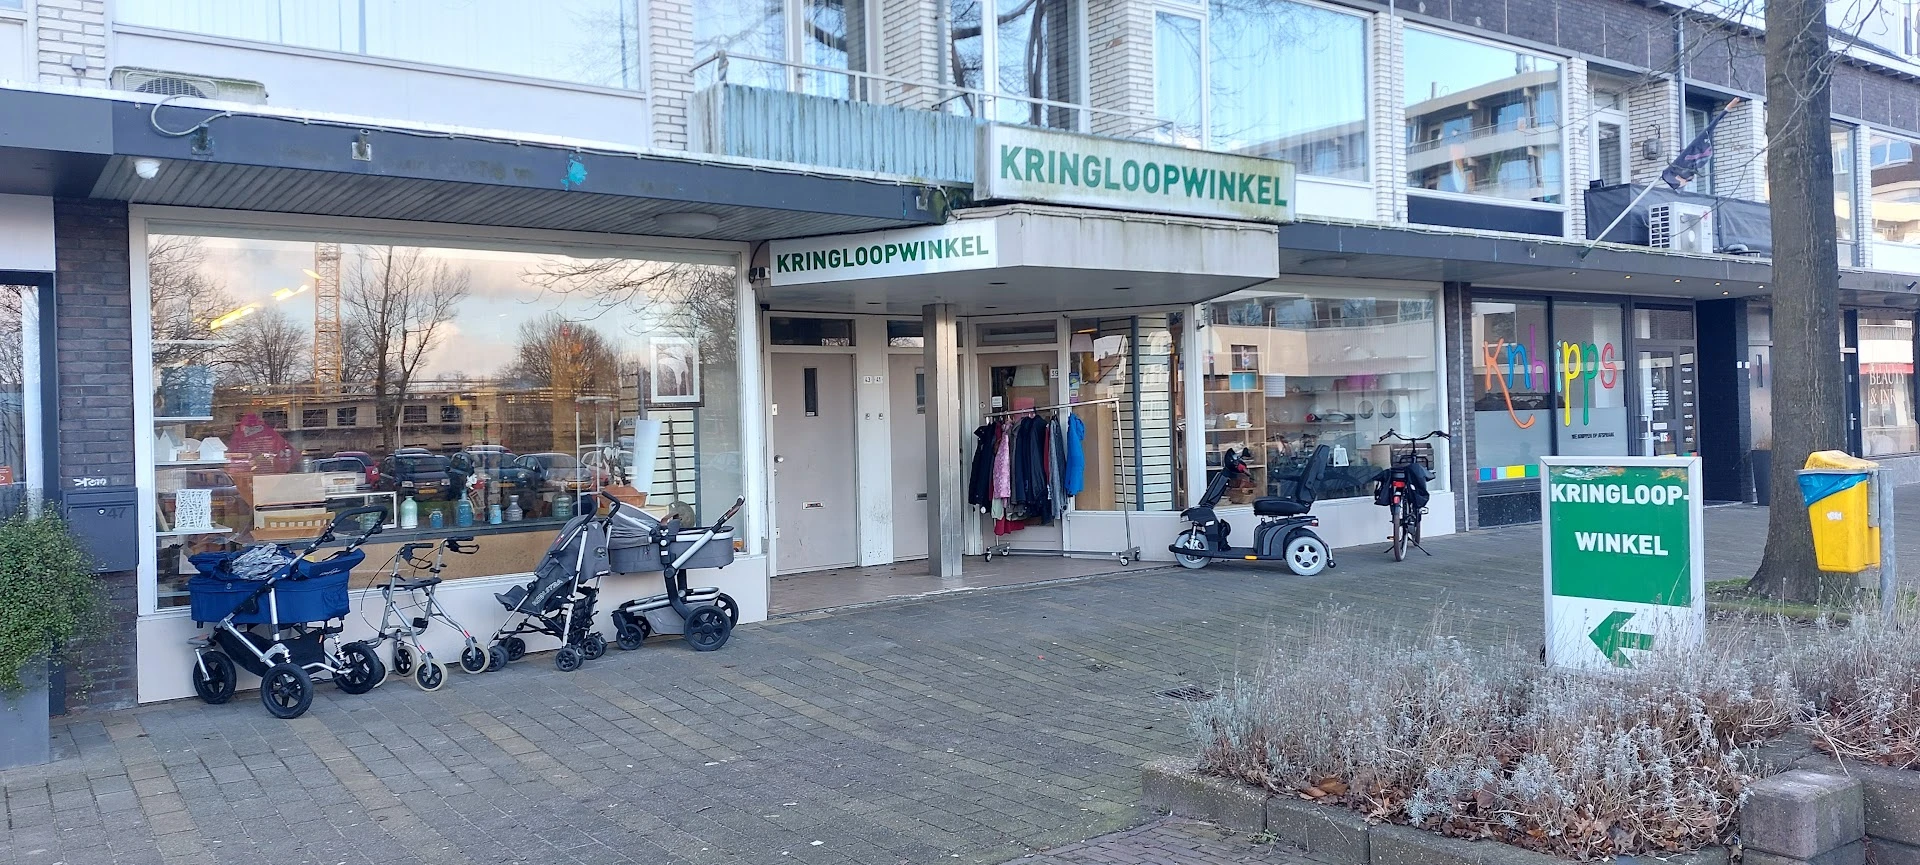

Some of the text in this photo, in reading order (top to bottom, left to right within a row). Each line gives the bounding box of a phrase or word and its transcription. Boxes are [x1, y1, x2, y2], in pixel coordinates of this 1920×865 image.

[1000, 144, 1288, 207] KRINGLOOPWINKEL
[777, 235, 989, 274] KRINGLOOPWINKEL
[1870, 370, 1905, 385] BEAUTY
[1870, 388, 1897, 405] & INK
[1550, 483, 1690, 506] KRINGLOOP-
[107, 507, 127, 519] 47
[1574, 531, 1669, 556] WINKEL
